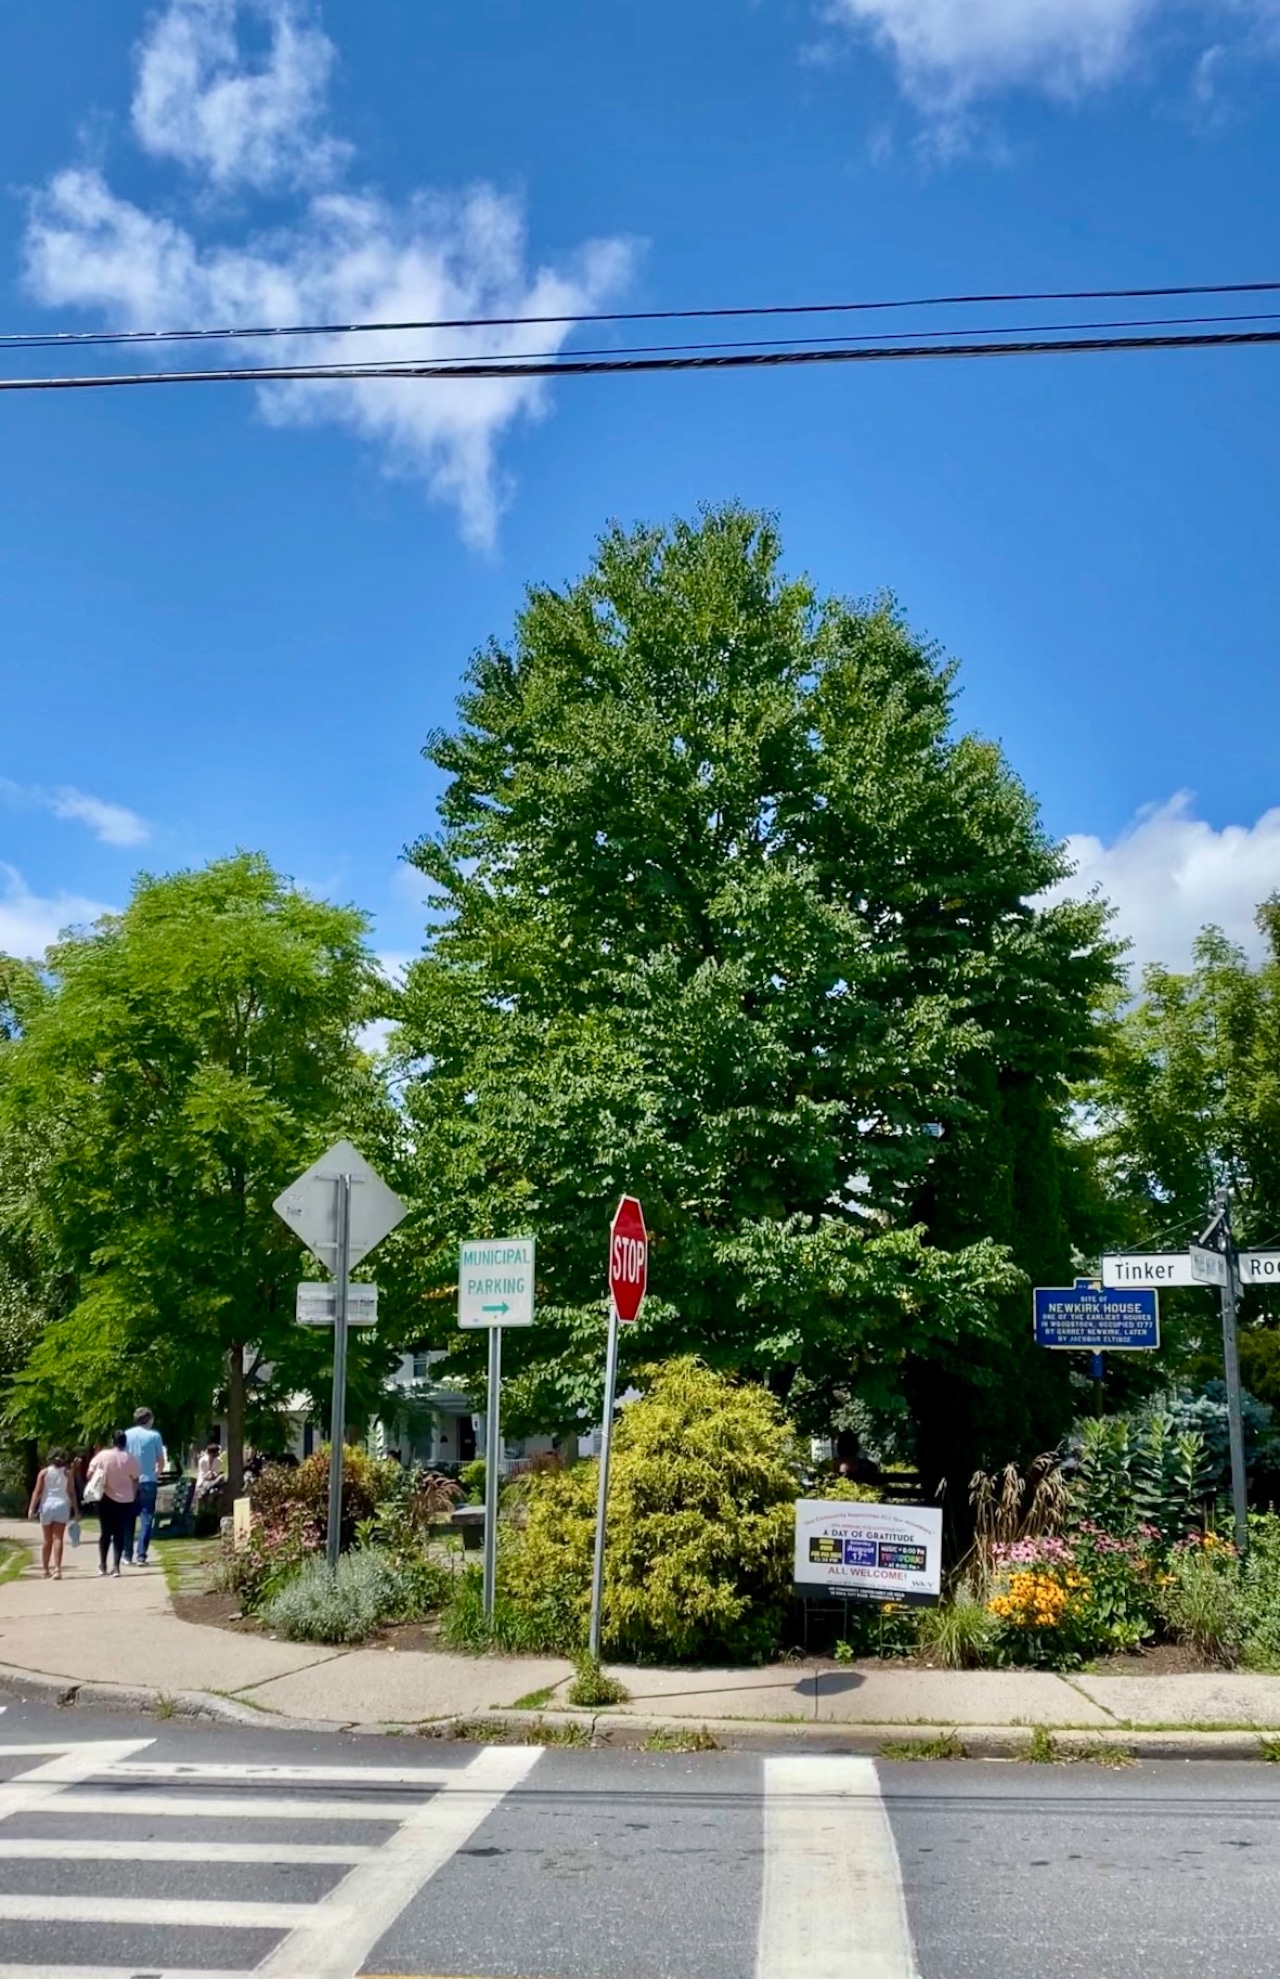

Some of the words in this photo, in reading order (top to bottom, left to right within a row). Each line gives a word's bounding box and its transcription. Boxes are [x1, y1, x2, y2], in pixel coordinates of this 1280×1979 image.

[463, 1248, 531, 1266] MUNICIPAL
[613, 1234, 645, 1284] STOP
[1115, 1262, 1175, 1280] Tinker
[1251, 1259, 1280, 1276] Ro
[468, 1278, 525, 1295] PARKING
[1080, 1295, 1097, 1303] SITE
[1099, 1295, 1107, 1303] OF
[1048, 1303, 1100, 1313] NEWKIRK
[1103, 1303, 1142, 1313] HOUSE
[1123, 1313, 1152, 1321] HOUSES
[1137, 1321, 1153, 1329] 1777
[831, 1529, 848, 1537] DAY
[851, 1530, 863, 1538] OF
[866, 1531, 914, 1542] GRATITUDE
[847, 1544, 875, 1554] August
[828, 1566, 848, 1575] ALL
[850, 1567, 908, 1580] WELCOME!
